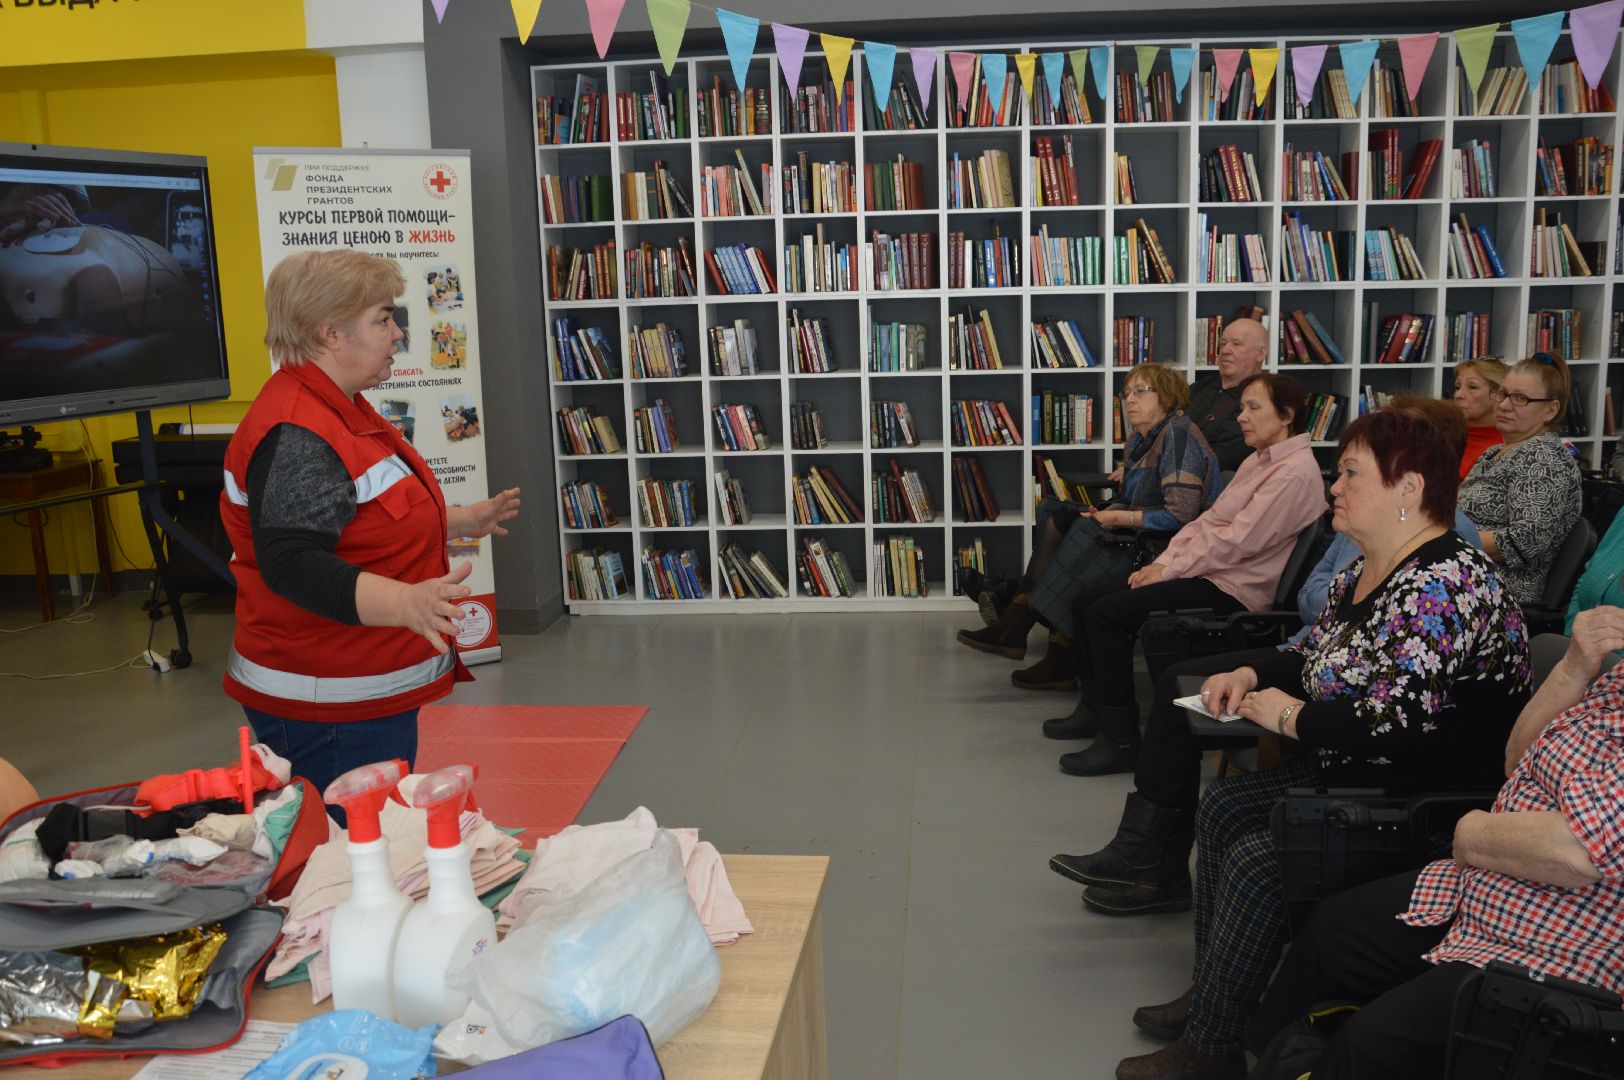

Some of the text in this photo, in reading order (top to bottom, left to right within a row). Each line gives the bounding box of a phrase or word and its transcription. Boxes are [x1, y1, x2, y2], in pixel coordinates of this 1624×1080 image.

[305, 174, 344, 183] ФОНДА
[306, 185, 393, 195] ПРЕЗИДЕНТСКИХ
[307, 197, 354, 205] ГРАНТОВ
[279, 210, 326, 225] КУРСЫ
[331, 208, 384, 224] ПЕРВОЙ
[282, 229, 456, 248] ЗНАНИЯ ЦЕНОЮ В ЖИЗНЬ
[399, 251, 440, 261] научитесь:
[393, 368, 424, 377] СПАСАТЬ
[418, 377, 462, 388] СОСТОЯНИЯХ
[426, 456, 448, 465] РЕТЕТЕ
[444, 475, 466, 485] ДЕТЯМ
